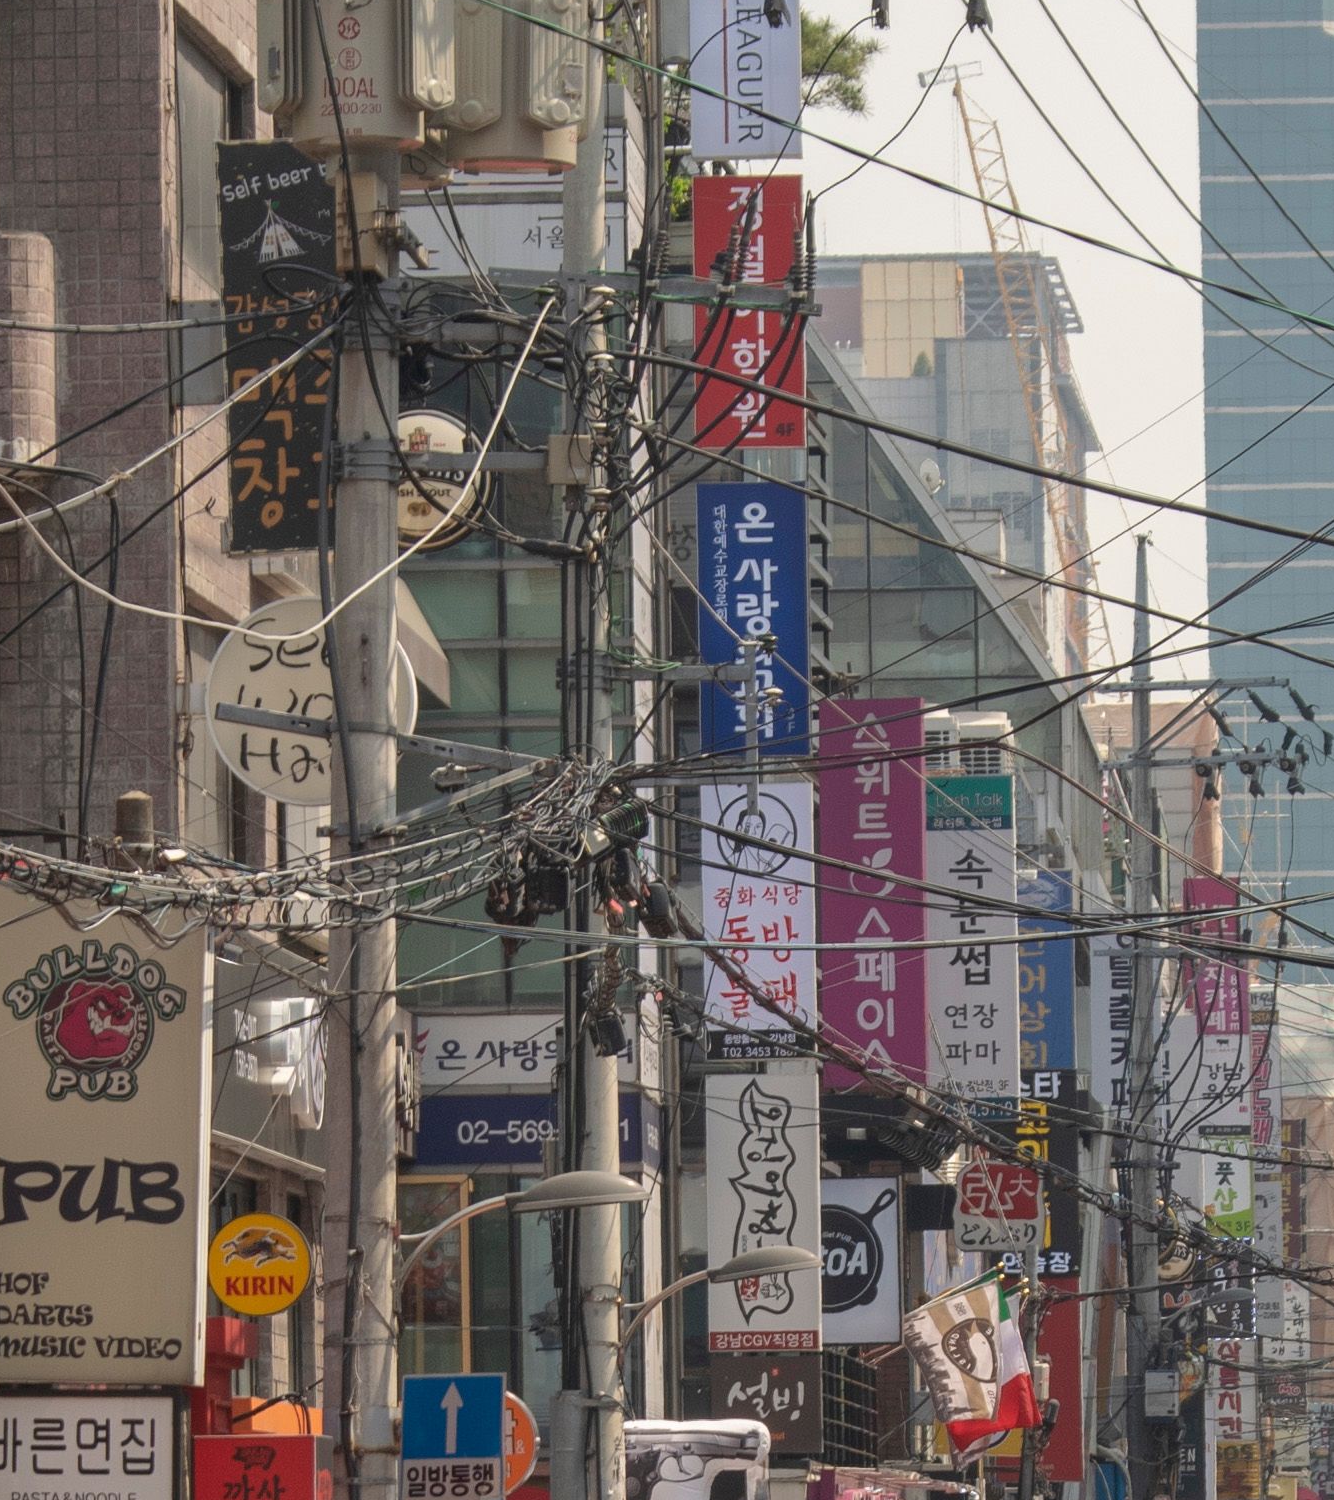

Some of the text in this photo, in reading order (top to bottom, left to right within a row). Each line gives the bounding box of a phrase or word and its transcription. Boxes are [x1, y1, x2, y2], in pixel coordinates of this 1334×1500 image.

[222, 169, 313, 203] Self beer
[733, 501, 775, 544] 온
[851, 710, 893, 842] 스위트
[714, 882, 803, 910] 중화식당
[3, 940, 187, 1022] BULLDOG
[853, 906, 897, 1067] 스페이스
[944, 1002, 999, 1030] 연장
[42, 1012, 66, 1065] DARTS
[435, 1039, 467, 1067] 온
[944, 1040, 1002, 1066] 파마
[47, 1066, 138, 1099] PUB
[224, 1275, 295, 1298] KIRIN
[98, 1334, 183, 1361] VIDEO
[714, 1331, 815, 1350] 강남CGV직영점
[727, 1368, 805, 1422] 설빙
[405, 1460, 496, 1498] 일방통행
